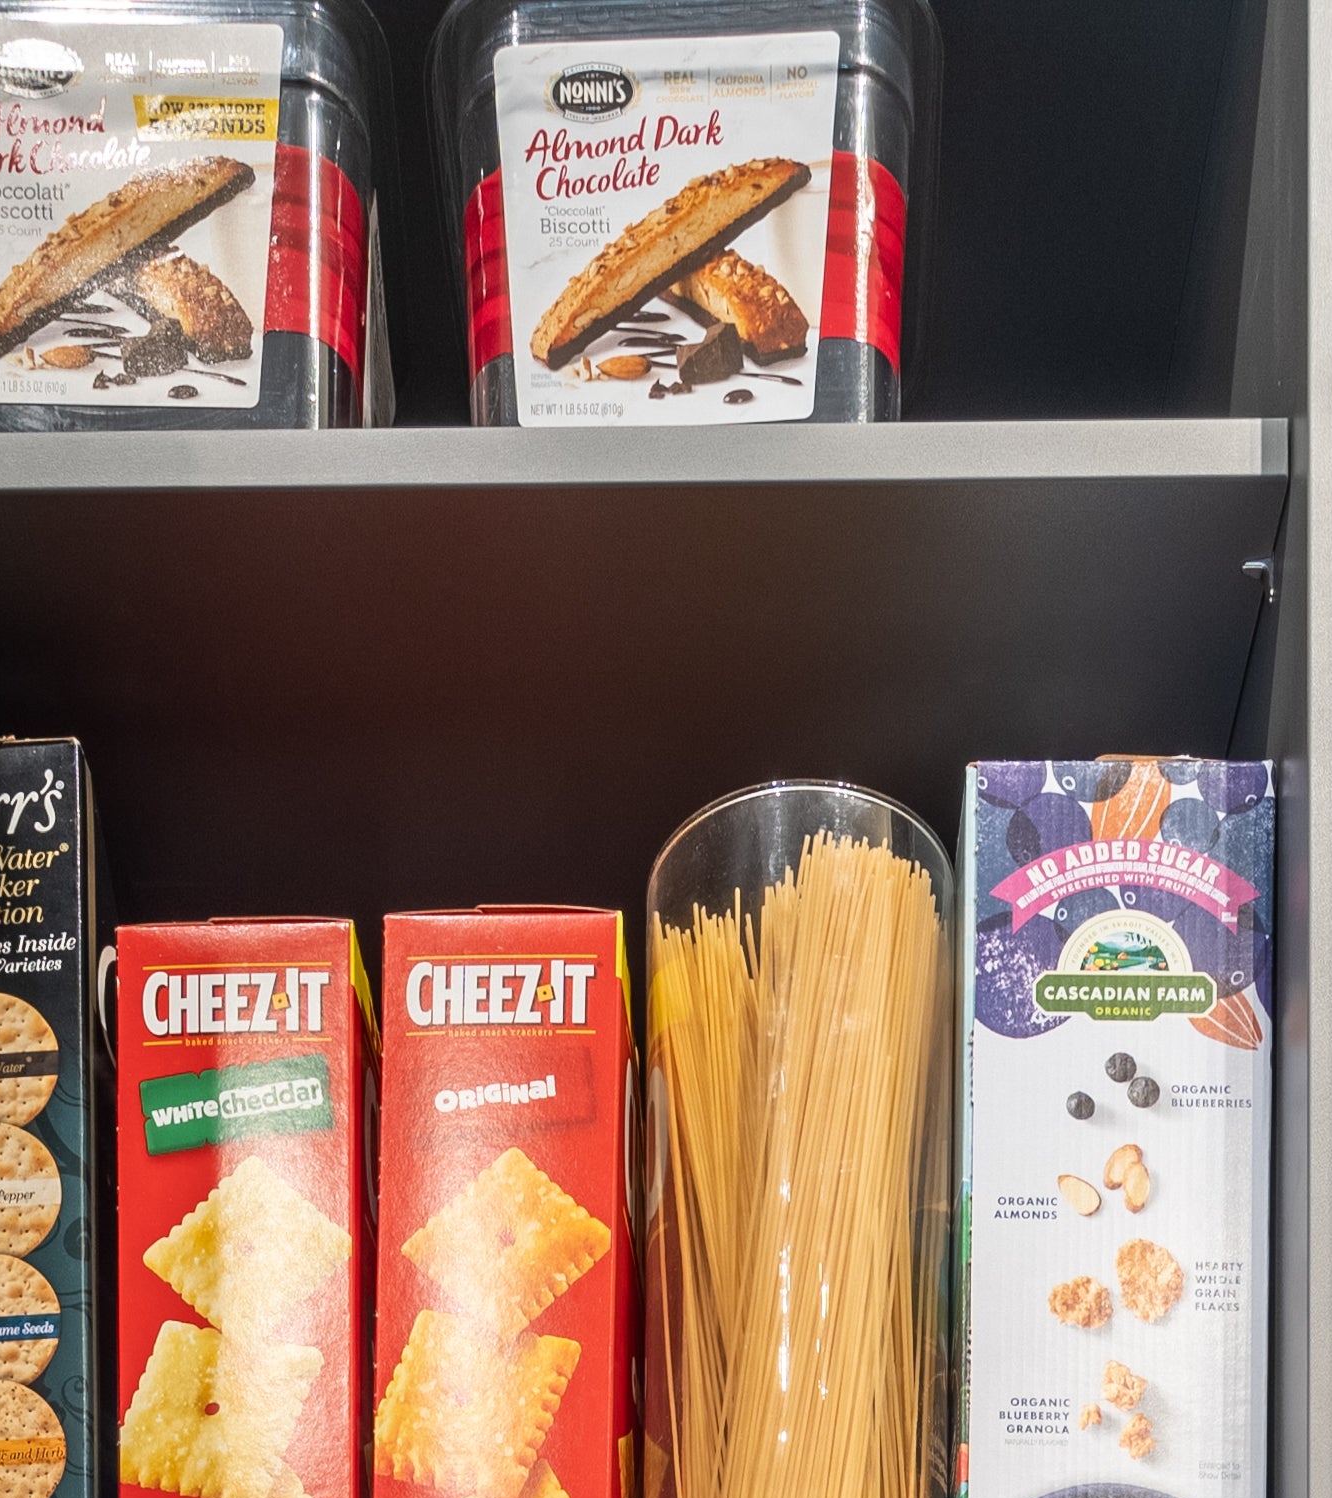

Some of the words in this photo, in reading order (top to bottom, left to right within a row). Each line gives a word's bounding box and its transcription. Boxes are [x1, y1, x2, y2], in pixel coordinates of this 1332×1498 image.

[559, 79, 627, 104] NONNI'S
[526, 116, 644, 163] Almond
[654, 109, 724, 151] Dark
[536, 162, 660, 201] Chocolate
[540, 219, 610, 234] Biscotti
[1027, 858, 1058, 885] NO
[1065, 840, 1141, 870] ADDED
[1147, 842, 1220, 884] SUGAR
[18, 933, 76, 953] Inside
[1044, 986, 1150, 1001] CASCADIAN
[1157, 986, 1206, 1002] FARM
[1095, 1007, 1151, 1016] ORGANIC
[220, 1080, 323, 1117] cheddar
[997, 1197, 1058, 1206] ORGANIC
[994, 1210, 1057, 1219] ALMONDS
[20, 1322, 54, 1335] Seeds
